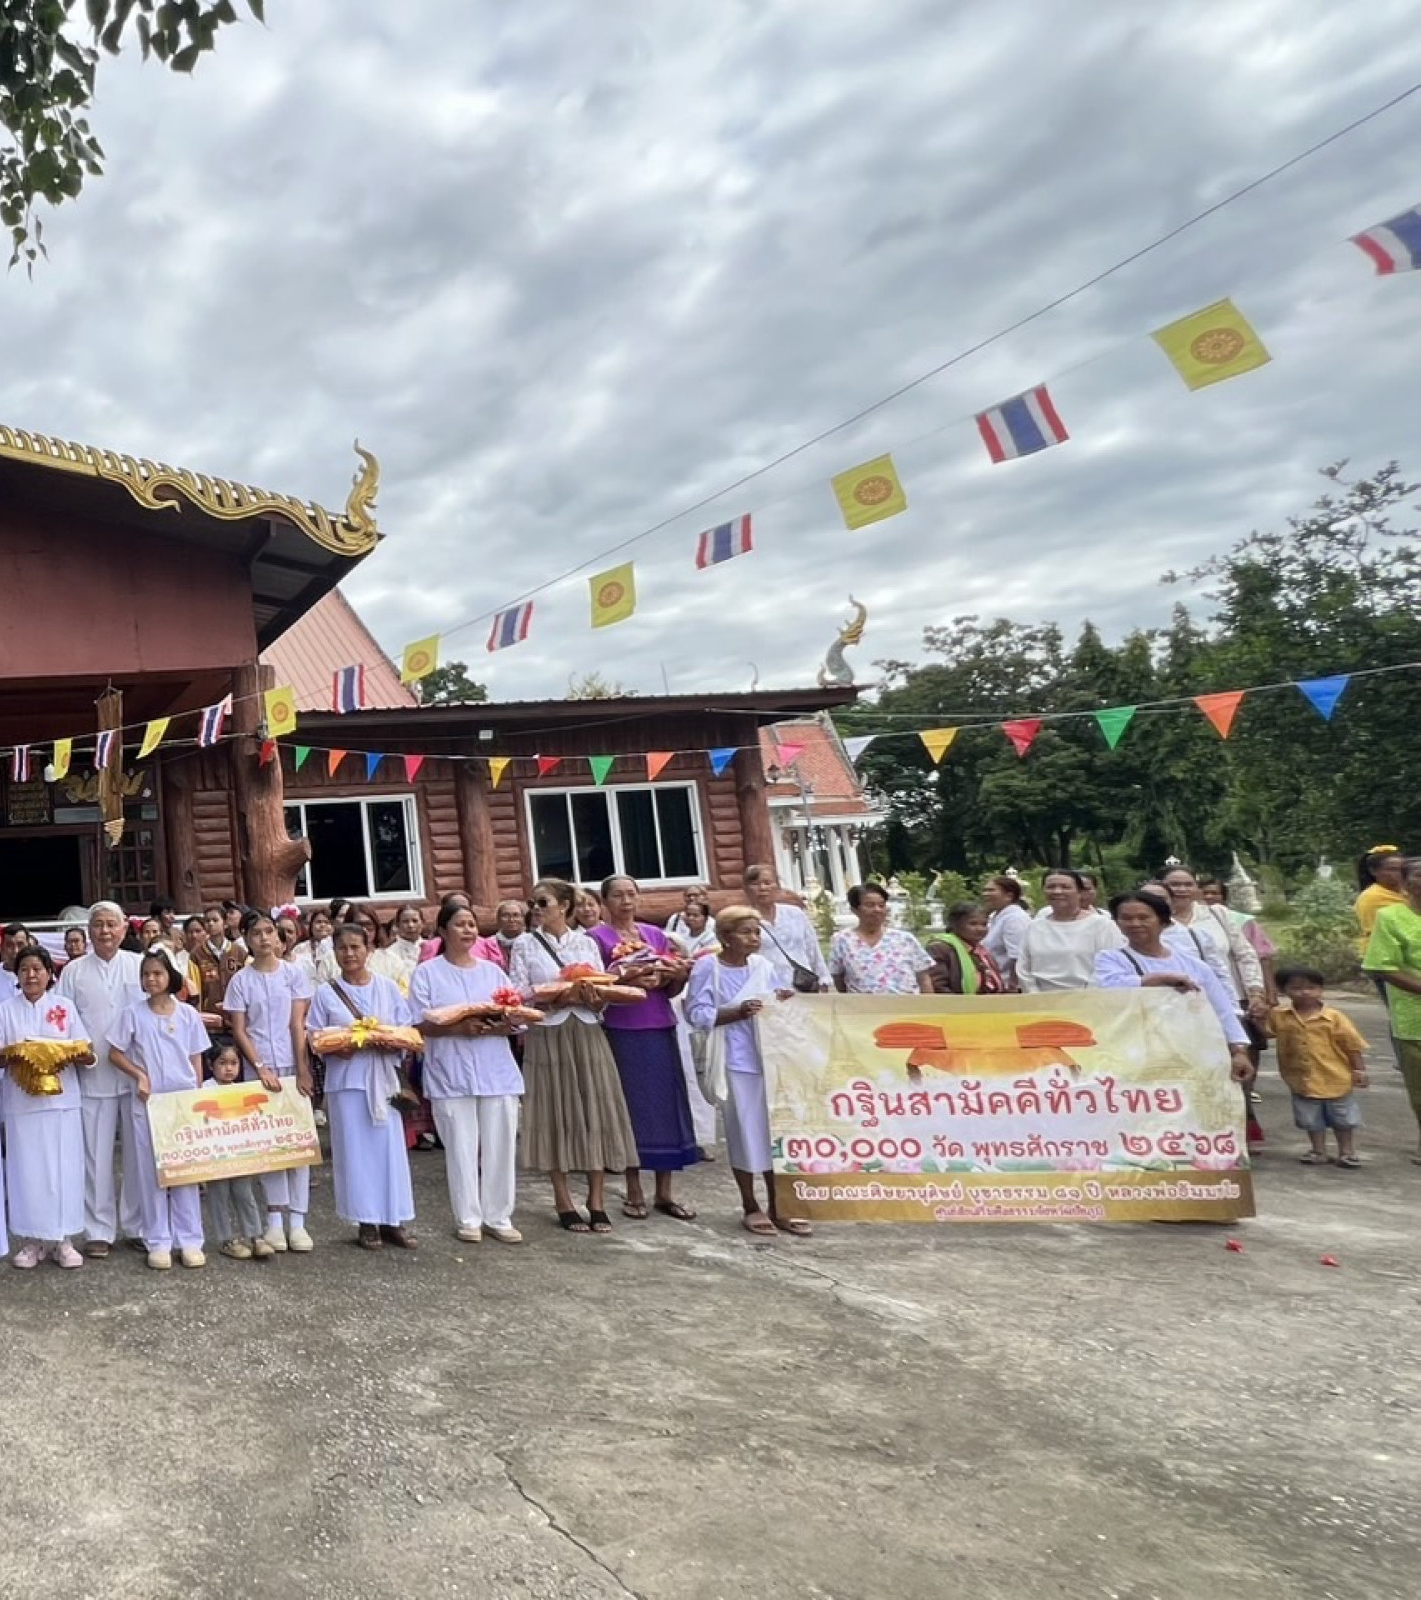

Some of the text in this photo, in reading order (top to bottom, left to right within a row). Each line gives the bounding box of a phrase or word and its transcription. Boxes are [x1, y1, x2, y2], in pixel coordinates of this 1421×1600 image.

[831, 1068, 1182, 1127] กฐินสามัคคีทั่วไทย
[787, 1131, 1236, 1165] ๓๐,๐๐๐ วัด พุทธศักราช ๒๕๖๘
[794, 1182, 828, 1200] โดย
[1084, 1181, 1102, 1199] ปี
